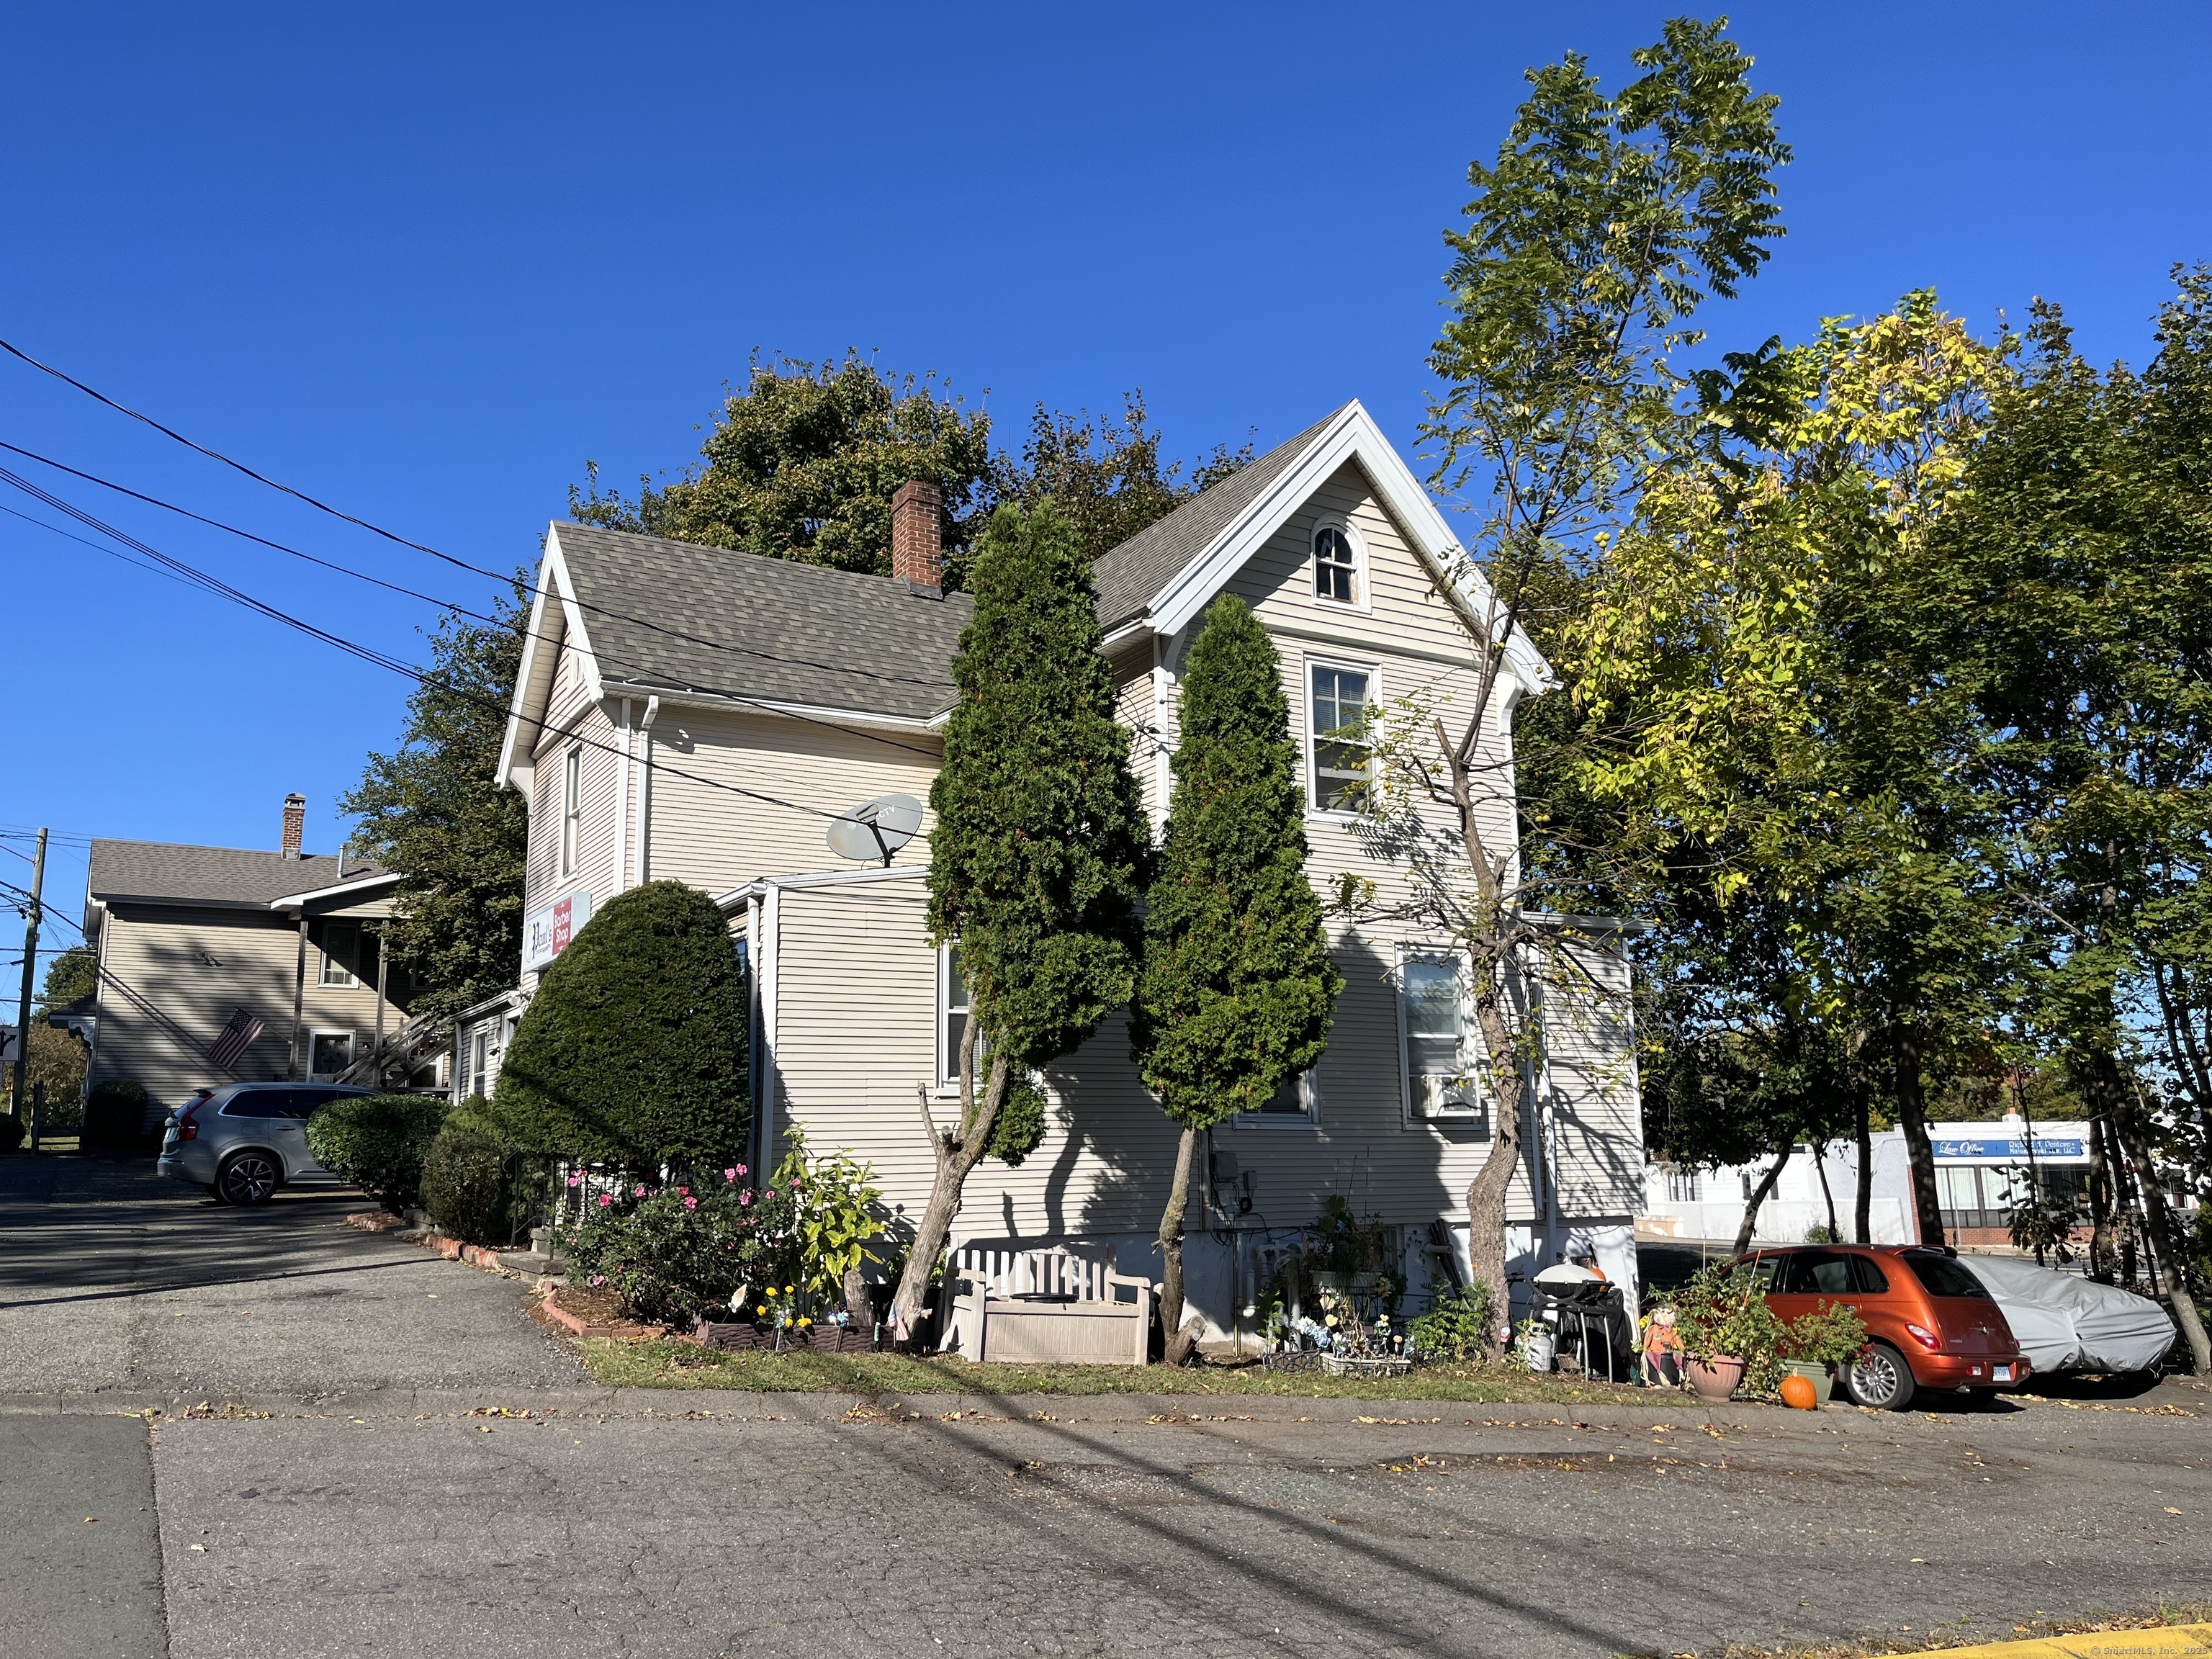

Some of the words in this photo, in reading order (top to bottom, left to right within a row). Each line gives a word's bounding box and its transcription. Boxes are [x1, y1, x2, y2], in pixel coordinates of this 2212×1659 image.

[554, 910, 570, 929] Barber
[532, 921, 552, 958] Paul's
[556, 927, 569, 943] Shop
[1938, 1141, 1958, 1156] Law
[1959, 1141, 1984, 1156] Office
